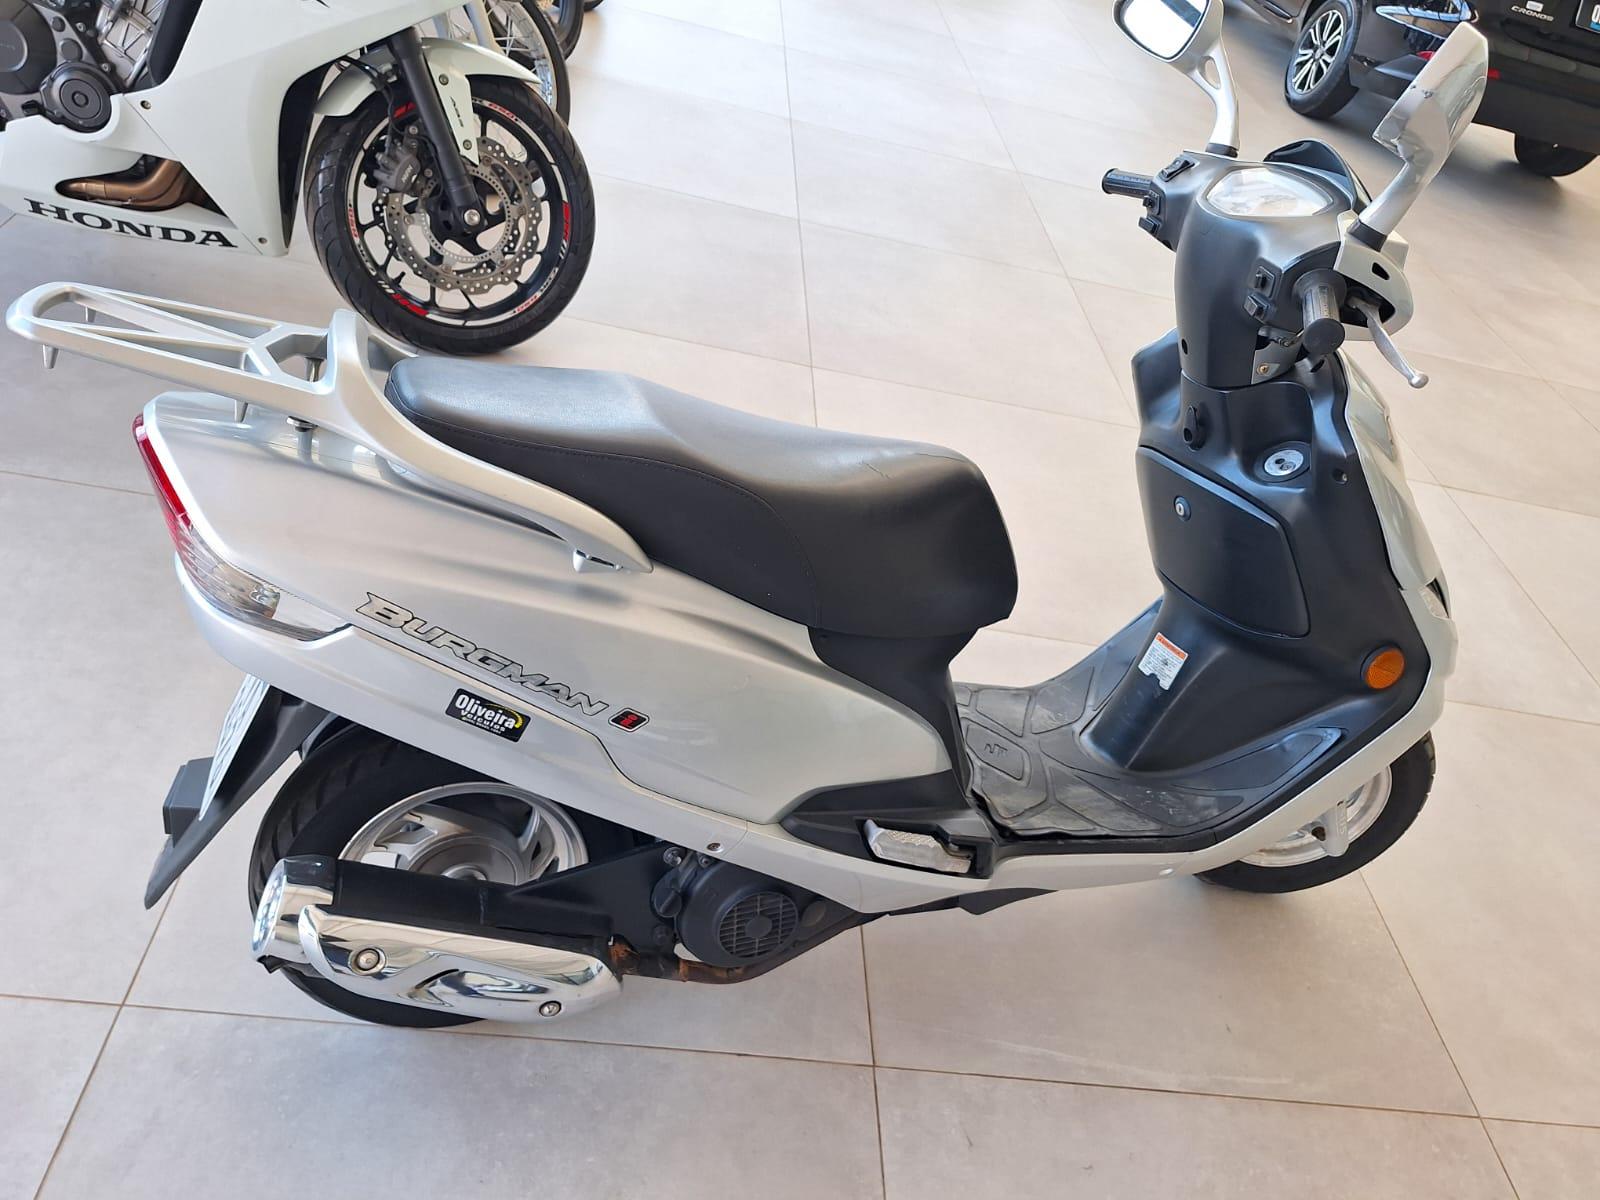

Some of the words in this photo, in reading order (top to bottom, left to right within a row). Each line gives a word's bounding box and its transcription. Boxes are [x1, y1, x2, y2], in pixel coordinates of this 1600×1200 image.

[1511, 5, 1554, 22] CRONOS
[23, 197, 238, 249] HONDA
[355, 591, 610, 717] BURGMAN
[455, 694, 516, 729] Oliveira
